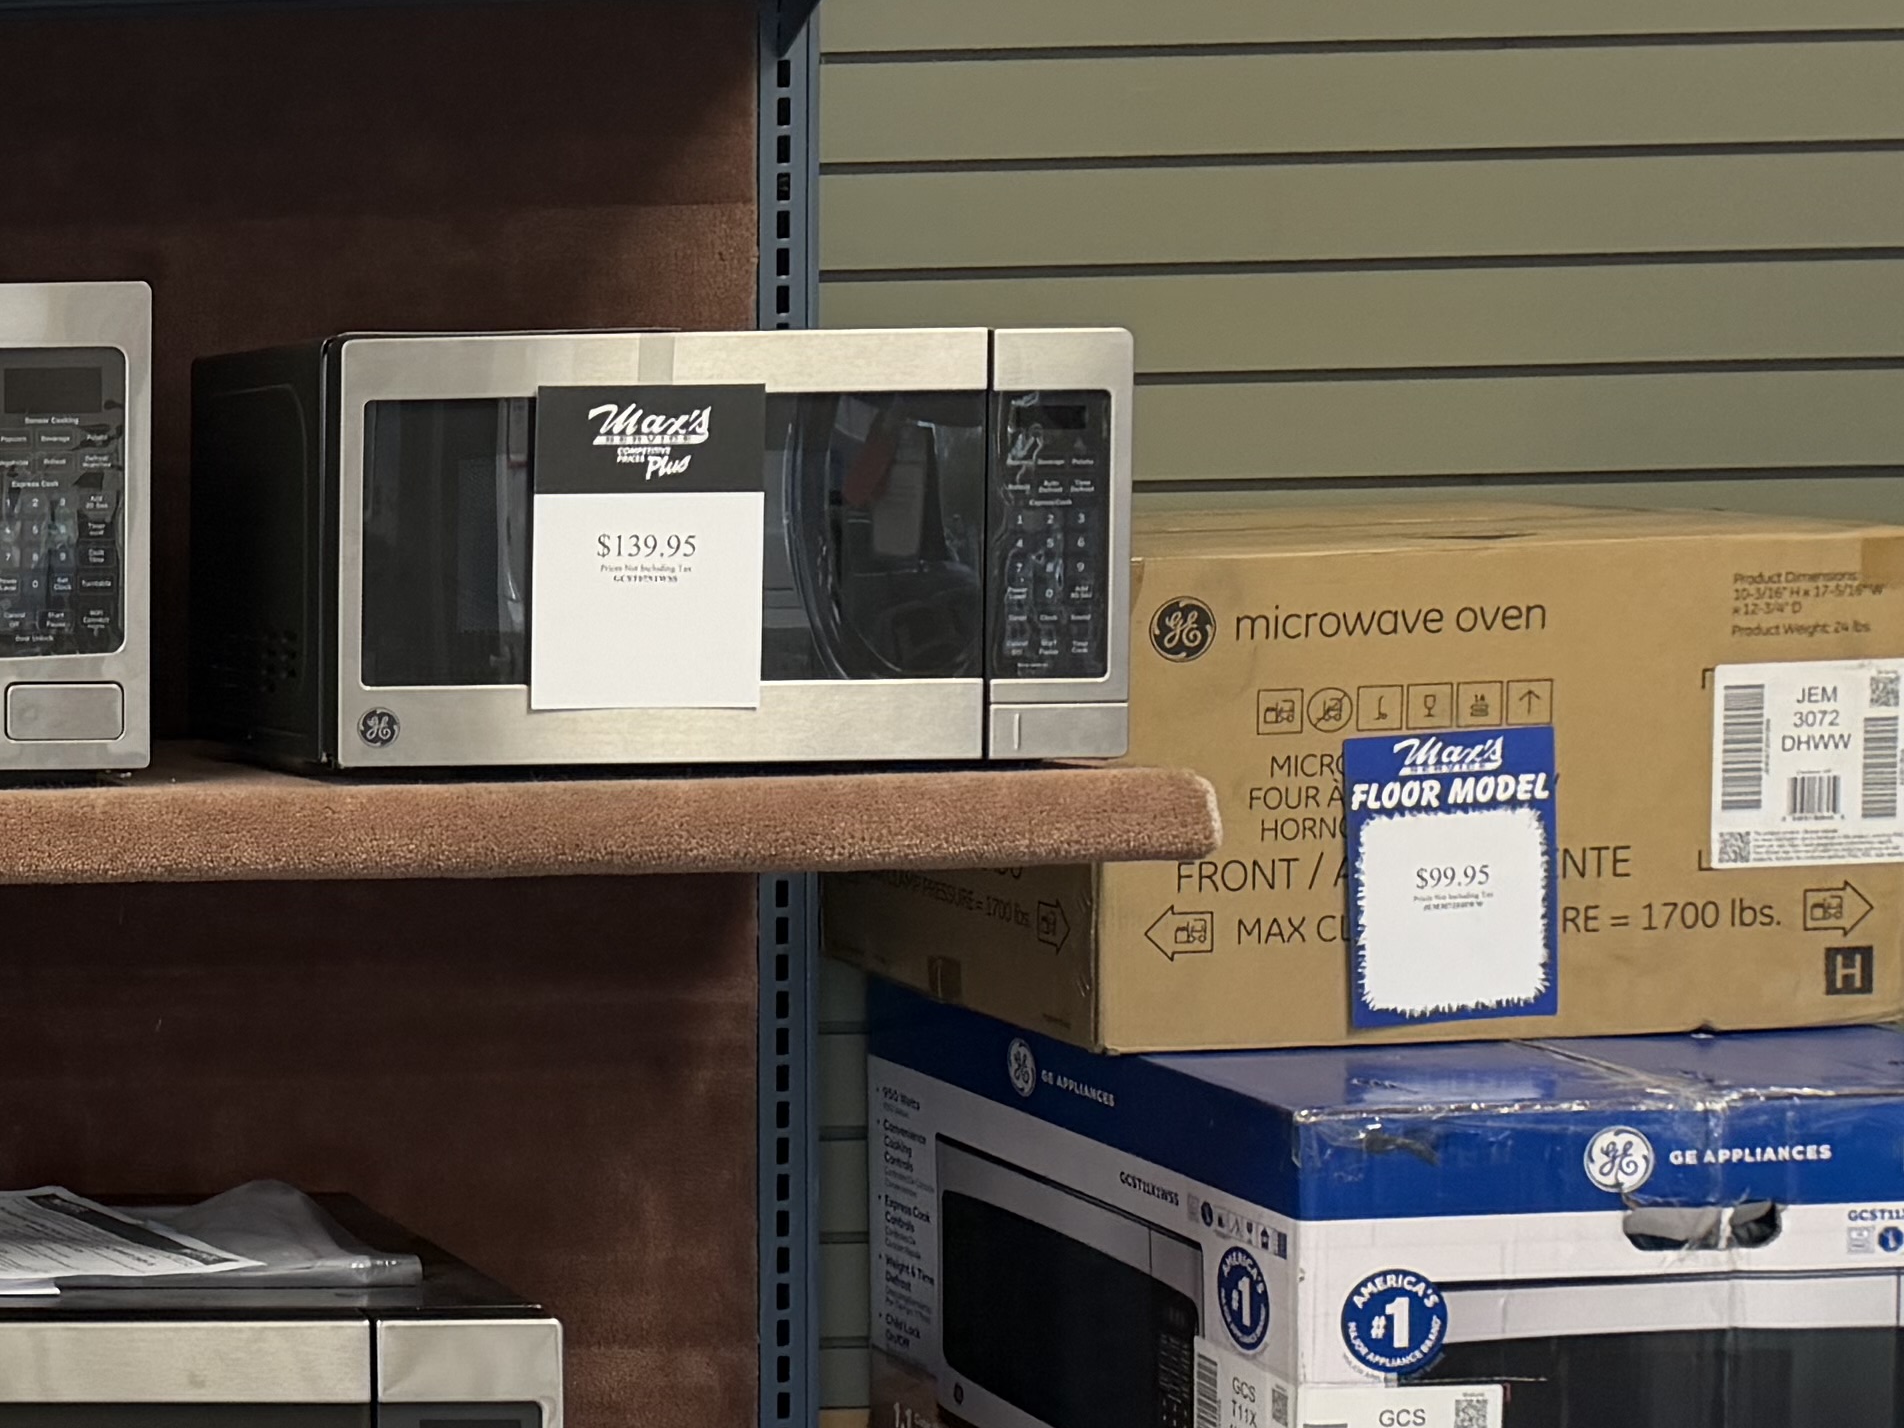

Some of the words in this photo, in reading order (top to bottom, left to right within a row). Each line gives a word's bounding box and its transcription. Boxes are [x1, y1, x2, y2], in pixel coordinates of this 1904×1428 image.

[588, 403, 711, 435] Max's
[646, 455, 691, 480] Plus
[597, 533, 696, 558] $139.95
[1235, 605, 1443, 641] microwave
[1456, 603, 1546, 633] oven
[1796, 686, 1838, 704] JEM
[1793, 710, 1840, 728] 3072
[1781, 733, 1852, 752] DHWW
[1351, 779, 1441, 810] FLOOR
[1447, 772, 1550, 805] MODEL
[1177, 858, 1300, 893] FRONT
[1416, 864, 1490, 890] $99.95
[1642, 901, 1719, 930] 1700
[1731, 898, 1781, 928] lbs.
[1237, 916, 1306, 945] MAX
[1669, 1150, 1698, 1165] GE
[1704, 1144, 1832, 1165] APPLIANCES
[1378, 1409, 1426, 1427] GCS
